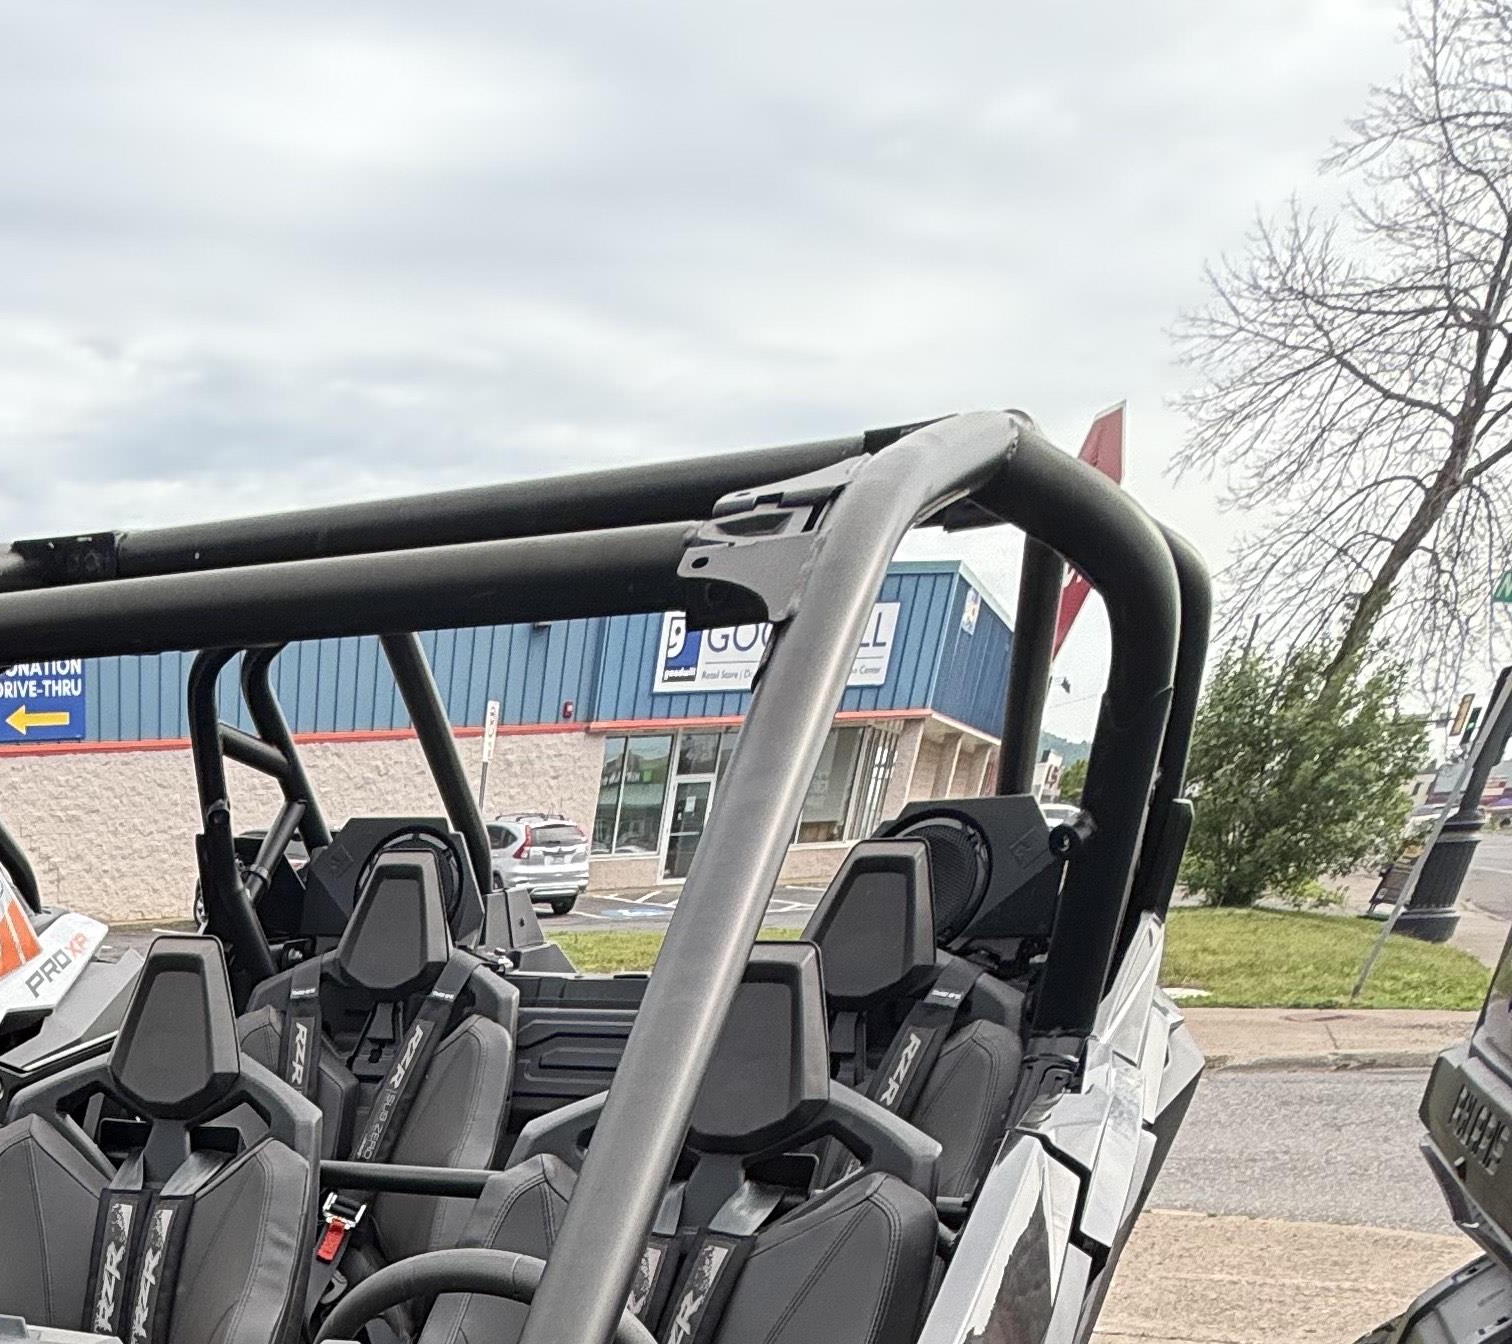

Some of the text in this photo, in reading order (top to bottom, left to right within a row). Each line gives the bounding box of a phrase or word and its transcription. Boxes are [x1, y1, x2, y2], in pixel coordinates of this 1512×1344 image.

[5, 659, 82, 677] ONATION
[25, 948, 73, 999] PRO
[290, 1021, 308, 1085] RZR
[389, 1024, 424, 1090] RZR
[879, 1033, 922, 1106] RZR
[94, 1241, 127, 1333] RZR
[131, 1247, 162, 1339] RZR
